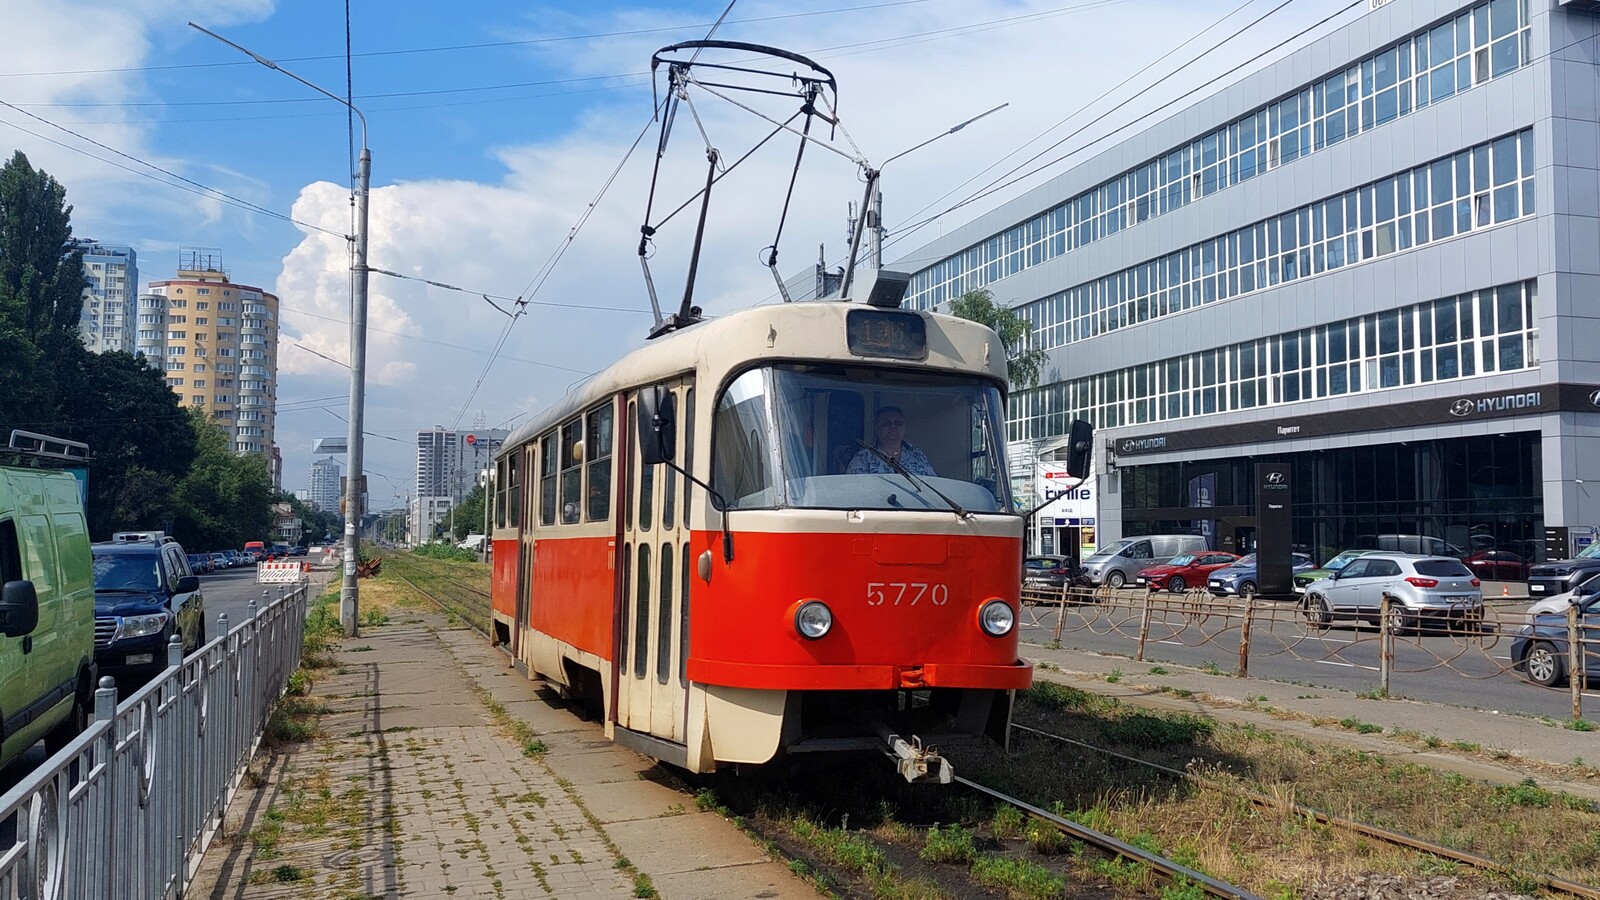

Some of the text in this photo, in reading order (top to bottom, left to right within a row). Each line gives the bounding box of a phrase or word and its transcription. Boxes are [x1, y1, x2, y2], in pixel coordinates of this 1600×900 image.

[1476, 391, 1541, 413] HYUNDAI
[1277, 426, 1300, 435] Паритет
[1135, 436, 1167, 450] HYUNDAI
[867, 582, 948, 606] 5770
